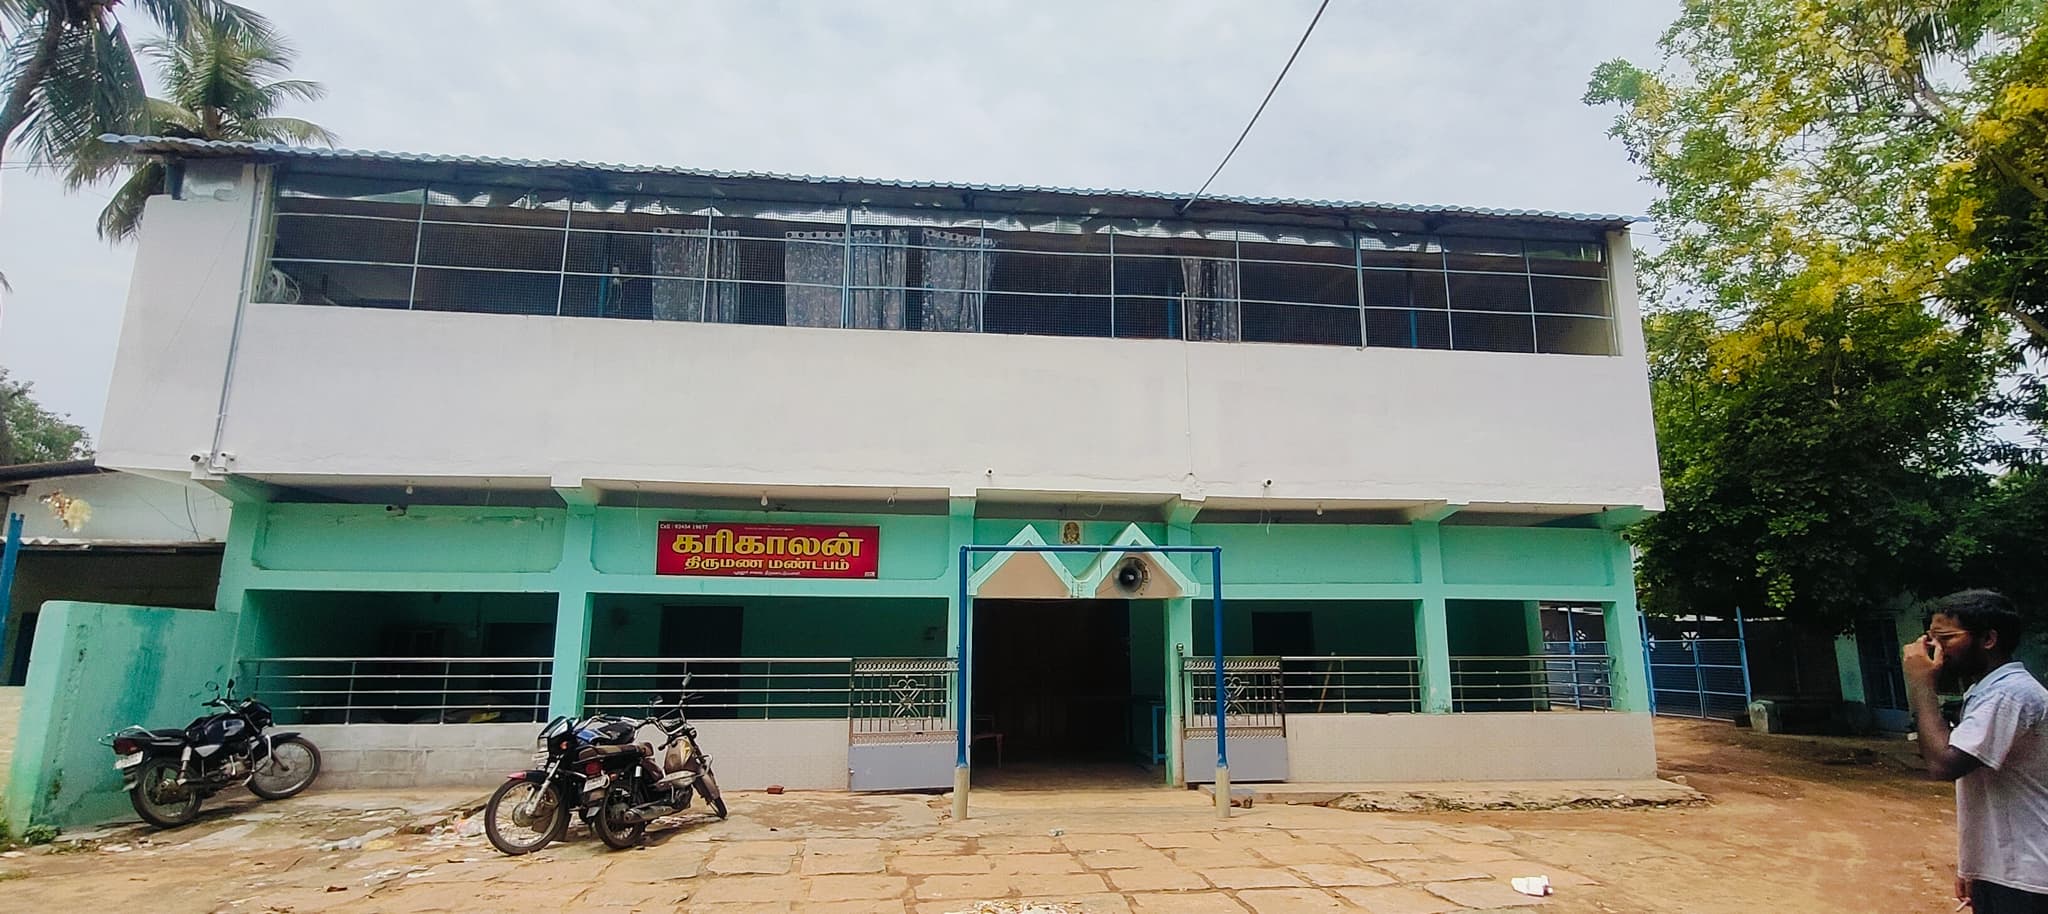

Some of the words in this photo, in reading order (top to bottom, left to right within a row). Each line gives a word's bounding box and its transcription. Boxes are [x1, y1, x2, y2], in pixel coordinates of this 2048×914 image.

[672, 529, 864, 557] கரிகாலன்
[684, 556, 764, 570] திருமண
[767, 557, 850, 571] மண்டபம்
